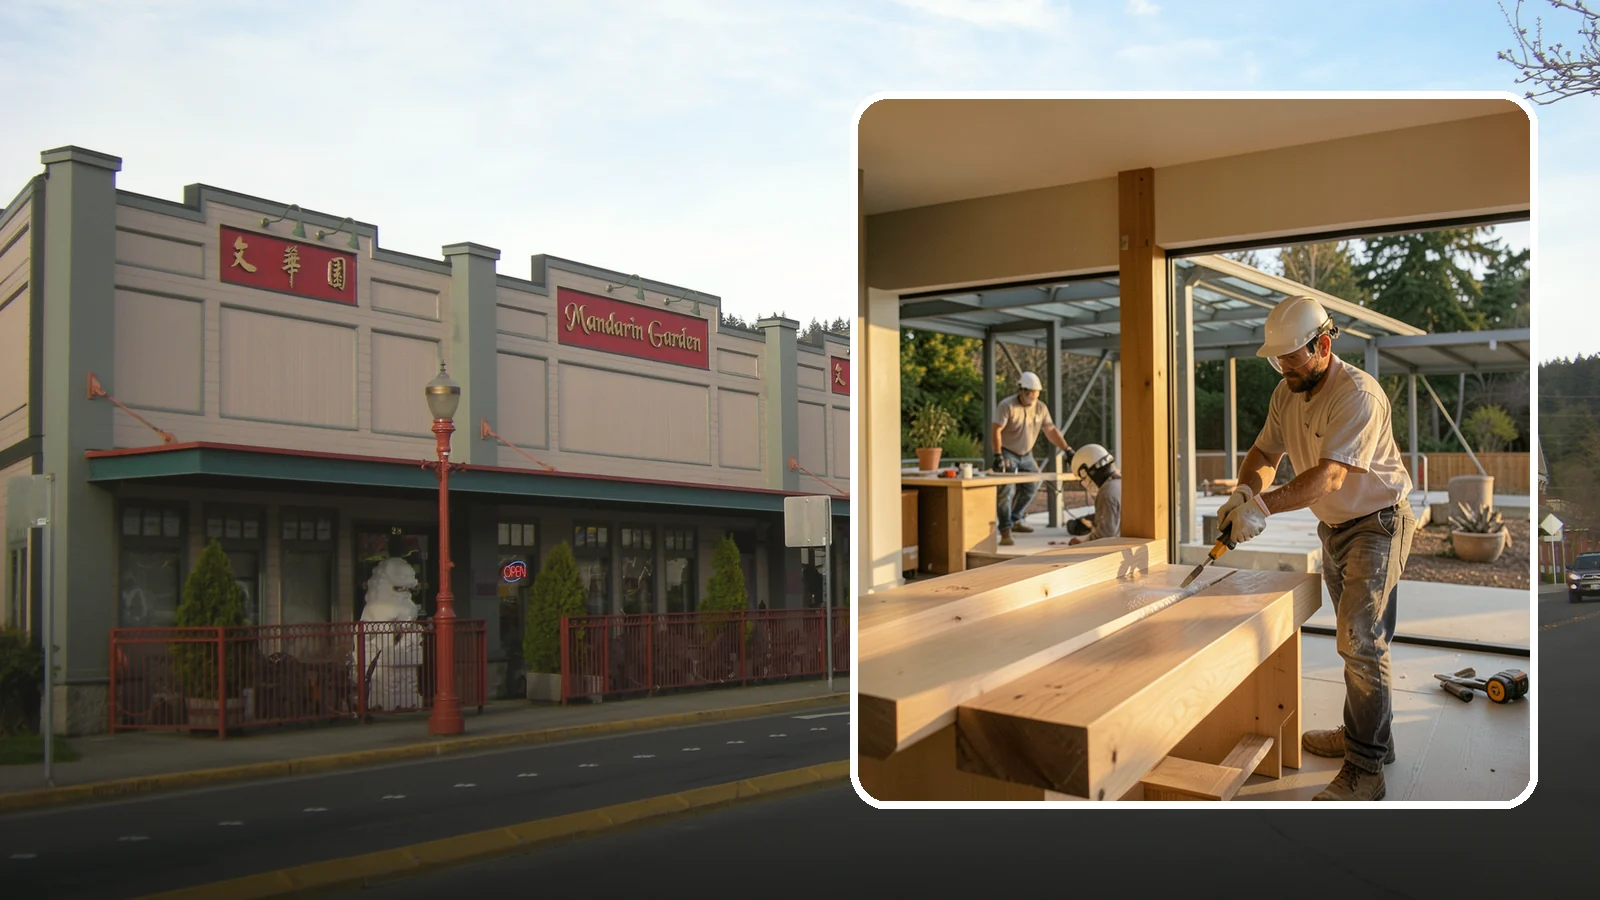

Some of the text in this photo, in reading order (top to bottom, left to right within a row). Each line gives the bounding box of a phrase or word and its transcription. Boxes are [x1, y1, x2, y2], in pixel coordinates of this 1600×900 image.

[231, 235, 346, 291] 文華園
[565, 302, 702, 352] Mandarin Garden
[503, 565, 527, 578] OPEN
